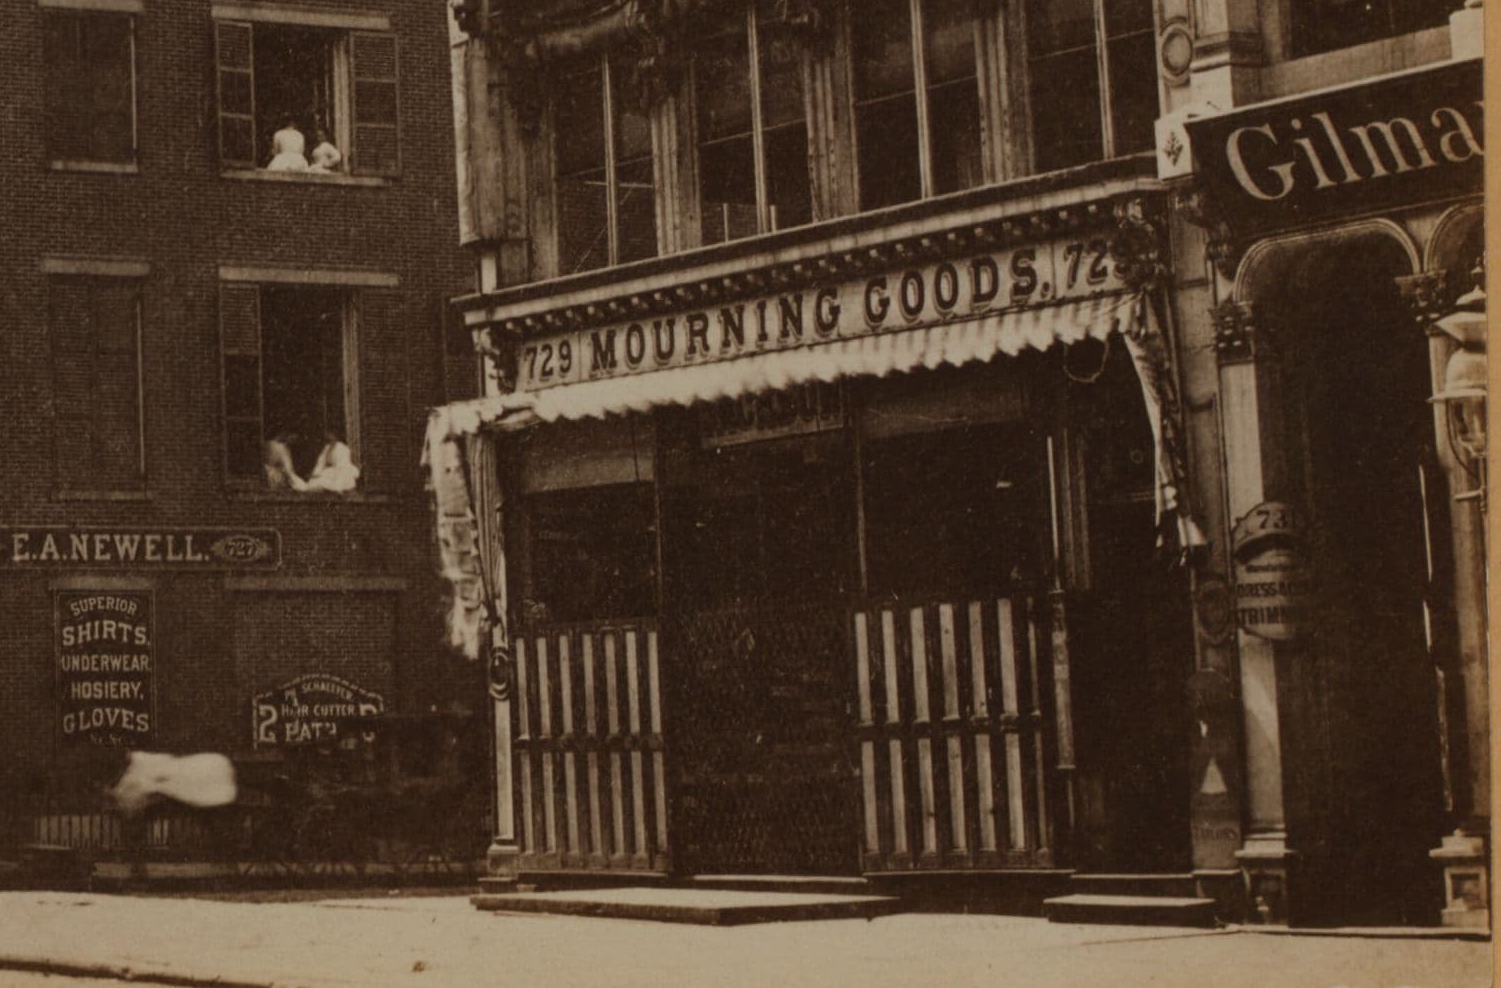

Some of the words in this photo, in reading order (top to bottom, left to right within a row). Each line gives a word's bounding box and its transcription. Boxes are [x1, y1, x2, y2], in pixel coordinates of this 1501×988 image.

[1226, 101, 1484, 201] Gilma
[524, 340, 573, 380] 729
[590, 286, 842, 377] MOURNING
[863, 249, 1053, 331] GOODS.
[228, 541, 253, 556] 727
[70, 596, 138, 617] SUPERIOR
[62, 707, 150, 734] GLOVES
